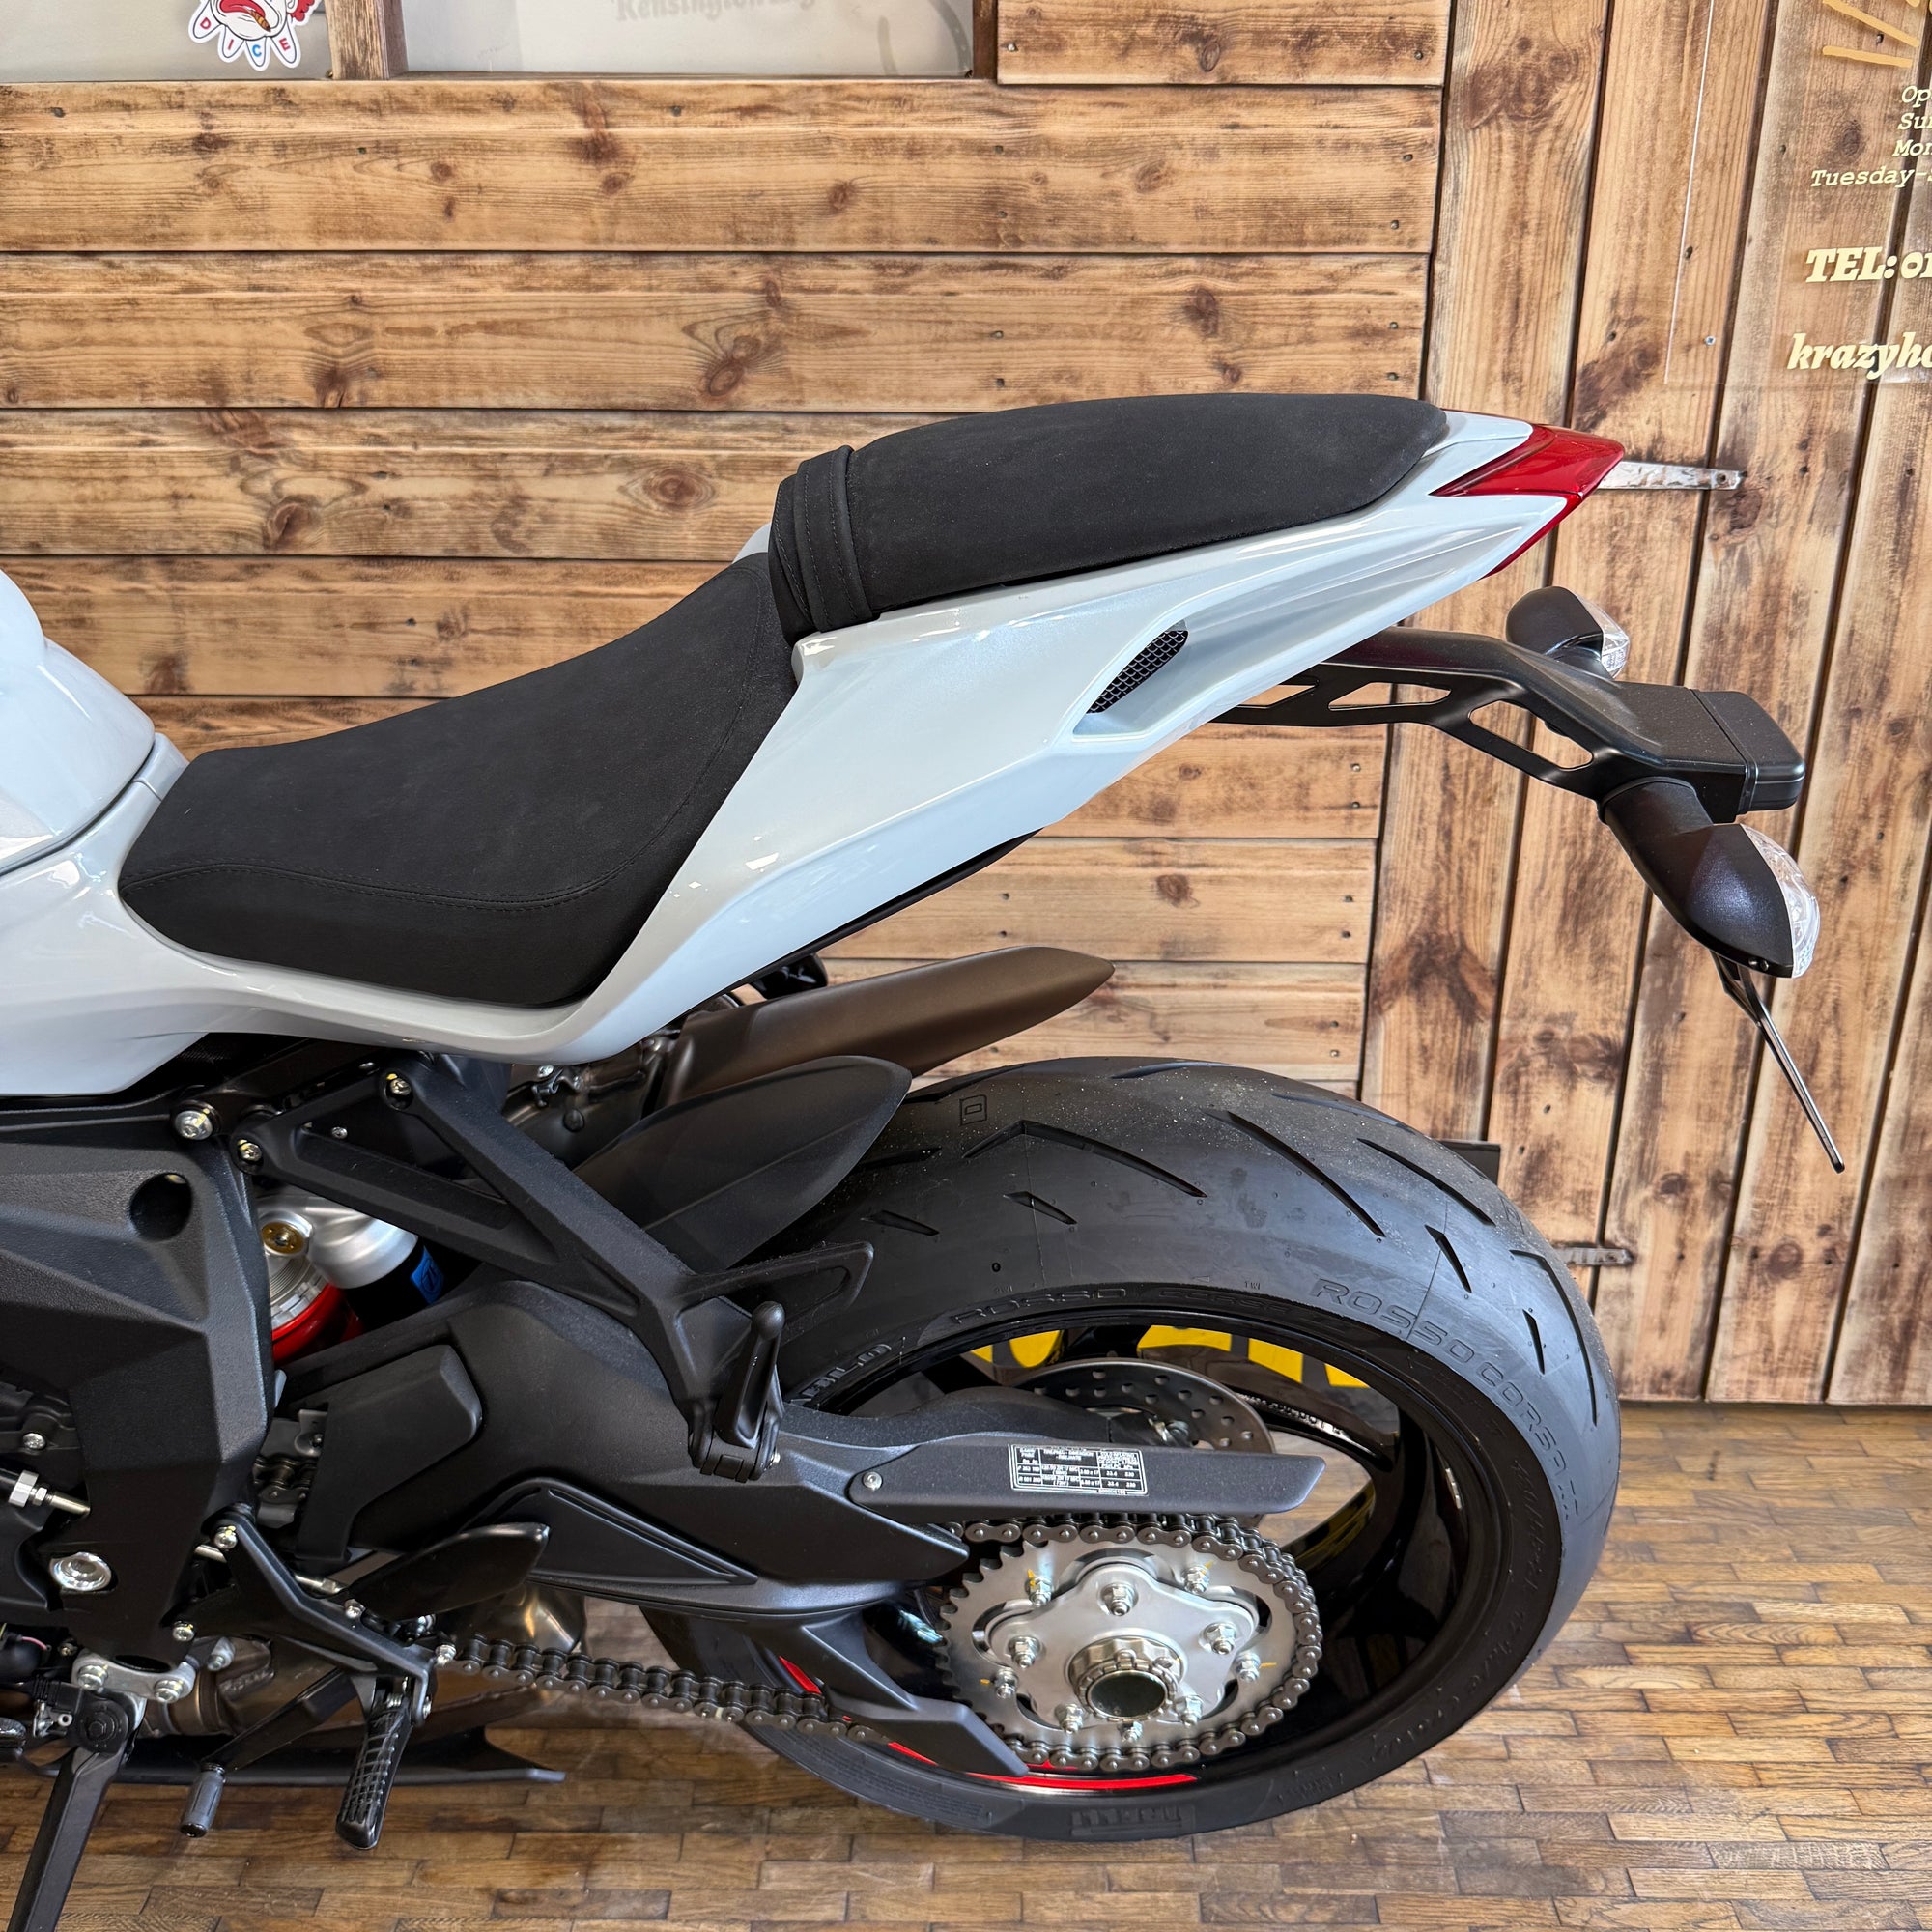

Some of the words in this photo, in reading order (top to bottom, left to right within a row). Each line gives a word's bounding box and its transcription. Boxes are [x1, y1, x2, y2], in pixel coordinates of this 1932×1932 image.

[1901, 85, 1932, 107] Op
[1810, 165, 1932, 188] Tuesday-
[1309, 1277, 1476, 1364] ROSSO
[1480, 1360, 1568, 1475] CORSA
